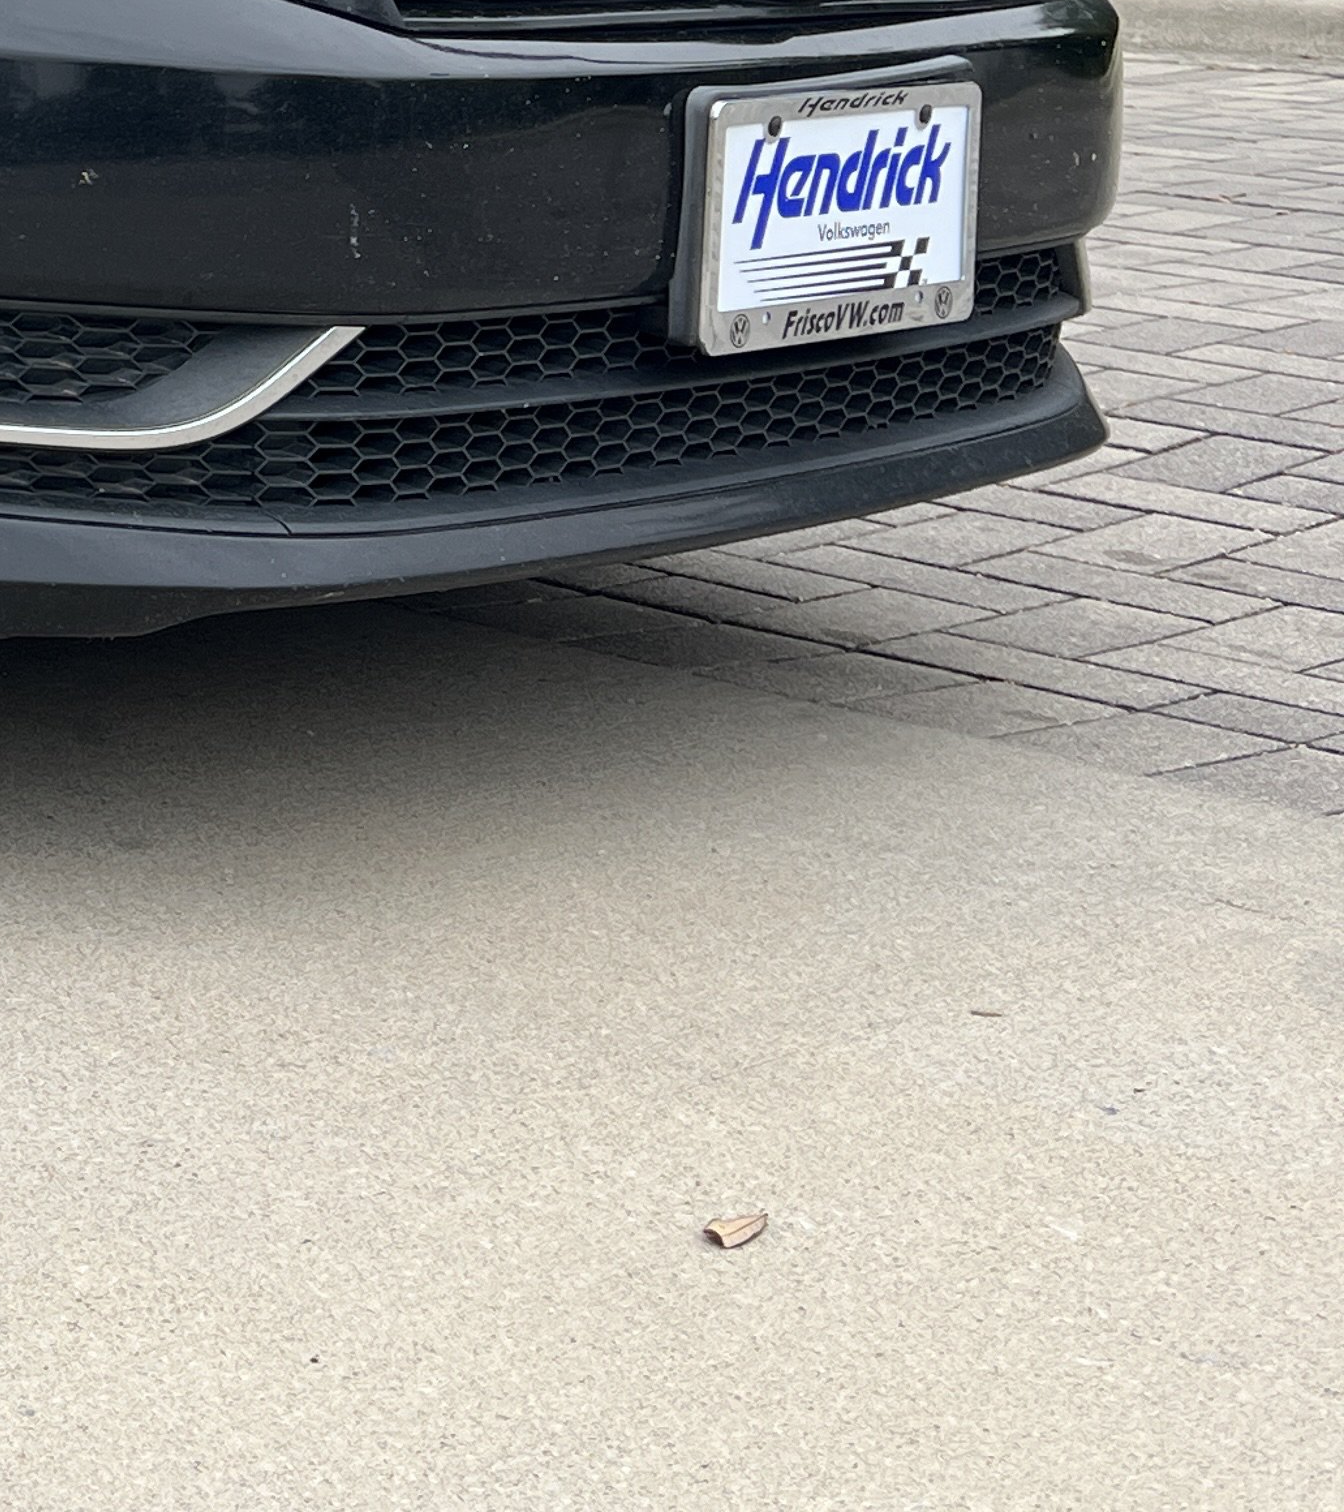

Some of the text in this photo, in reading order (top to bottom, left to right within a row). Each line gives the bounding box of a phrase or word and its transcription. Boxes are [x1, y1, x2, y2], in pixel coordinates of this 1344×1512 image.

[797, 90, 910, 118] Hendrick
[732, 123, 952, 251] Hendrick
[817, 220, 891, 243] Volkswagen
[781, 300, 906, 340] FriscoVW.com
